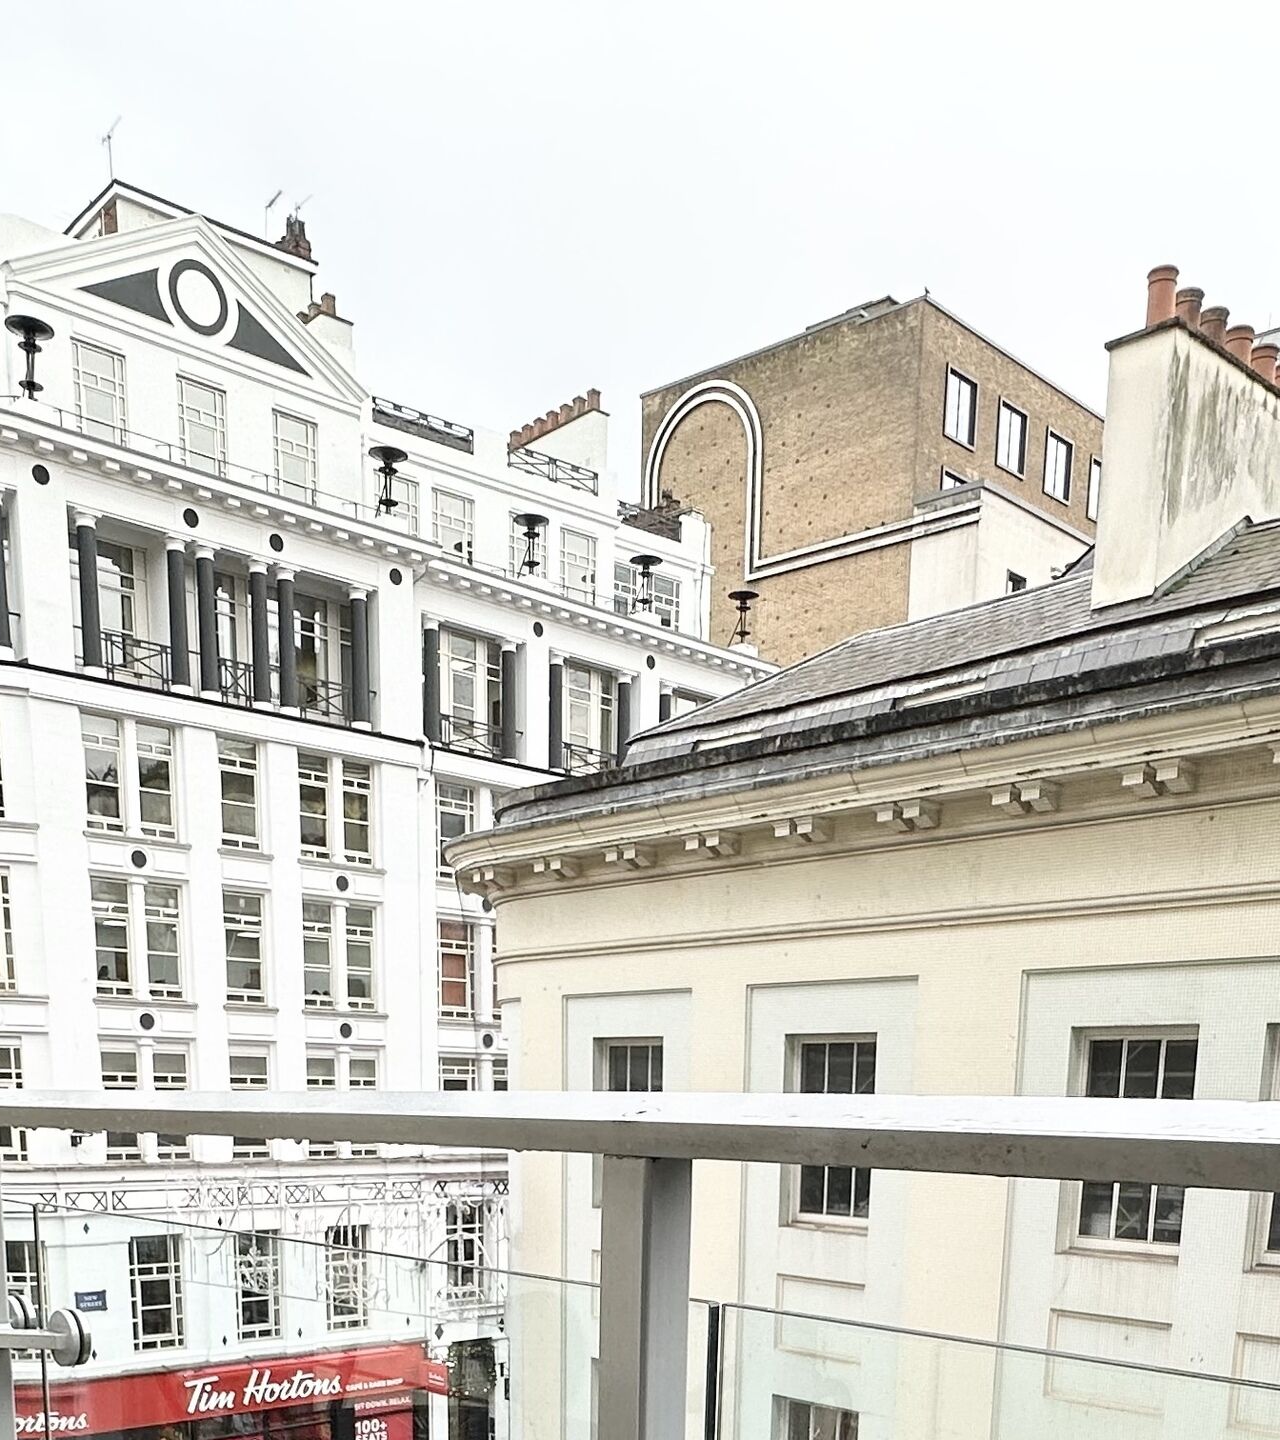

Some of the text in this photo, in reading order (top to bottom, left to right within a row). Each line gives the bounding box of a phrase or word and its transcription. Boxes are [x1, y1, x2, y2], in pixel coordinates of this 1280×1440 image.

[184, 1369, 341, 1414] Tim Hortons
[16, 1411, 89, 1433] ortons
[354, 1419, 388, 1435] 100+
